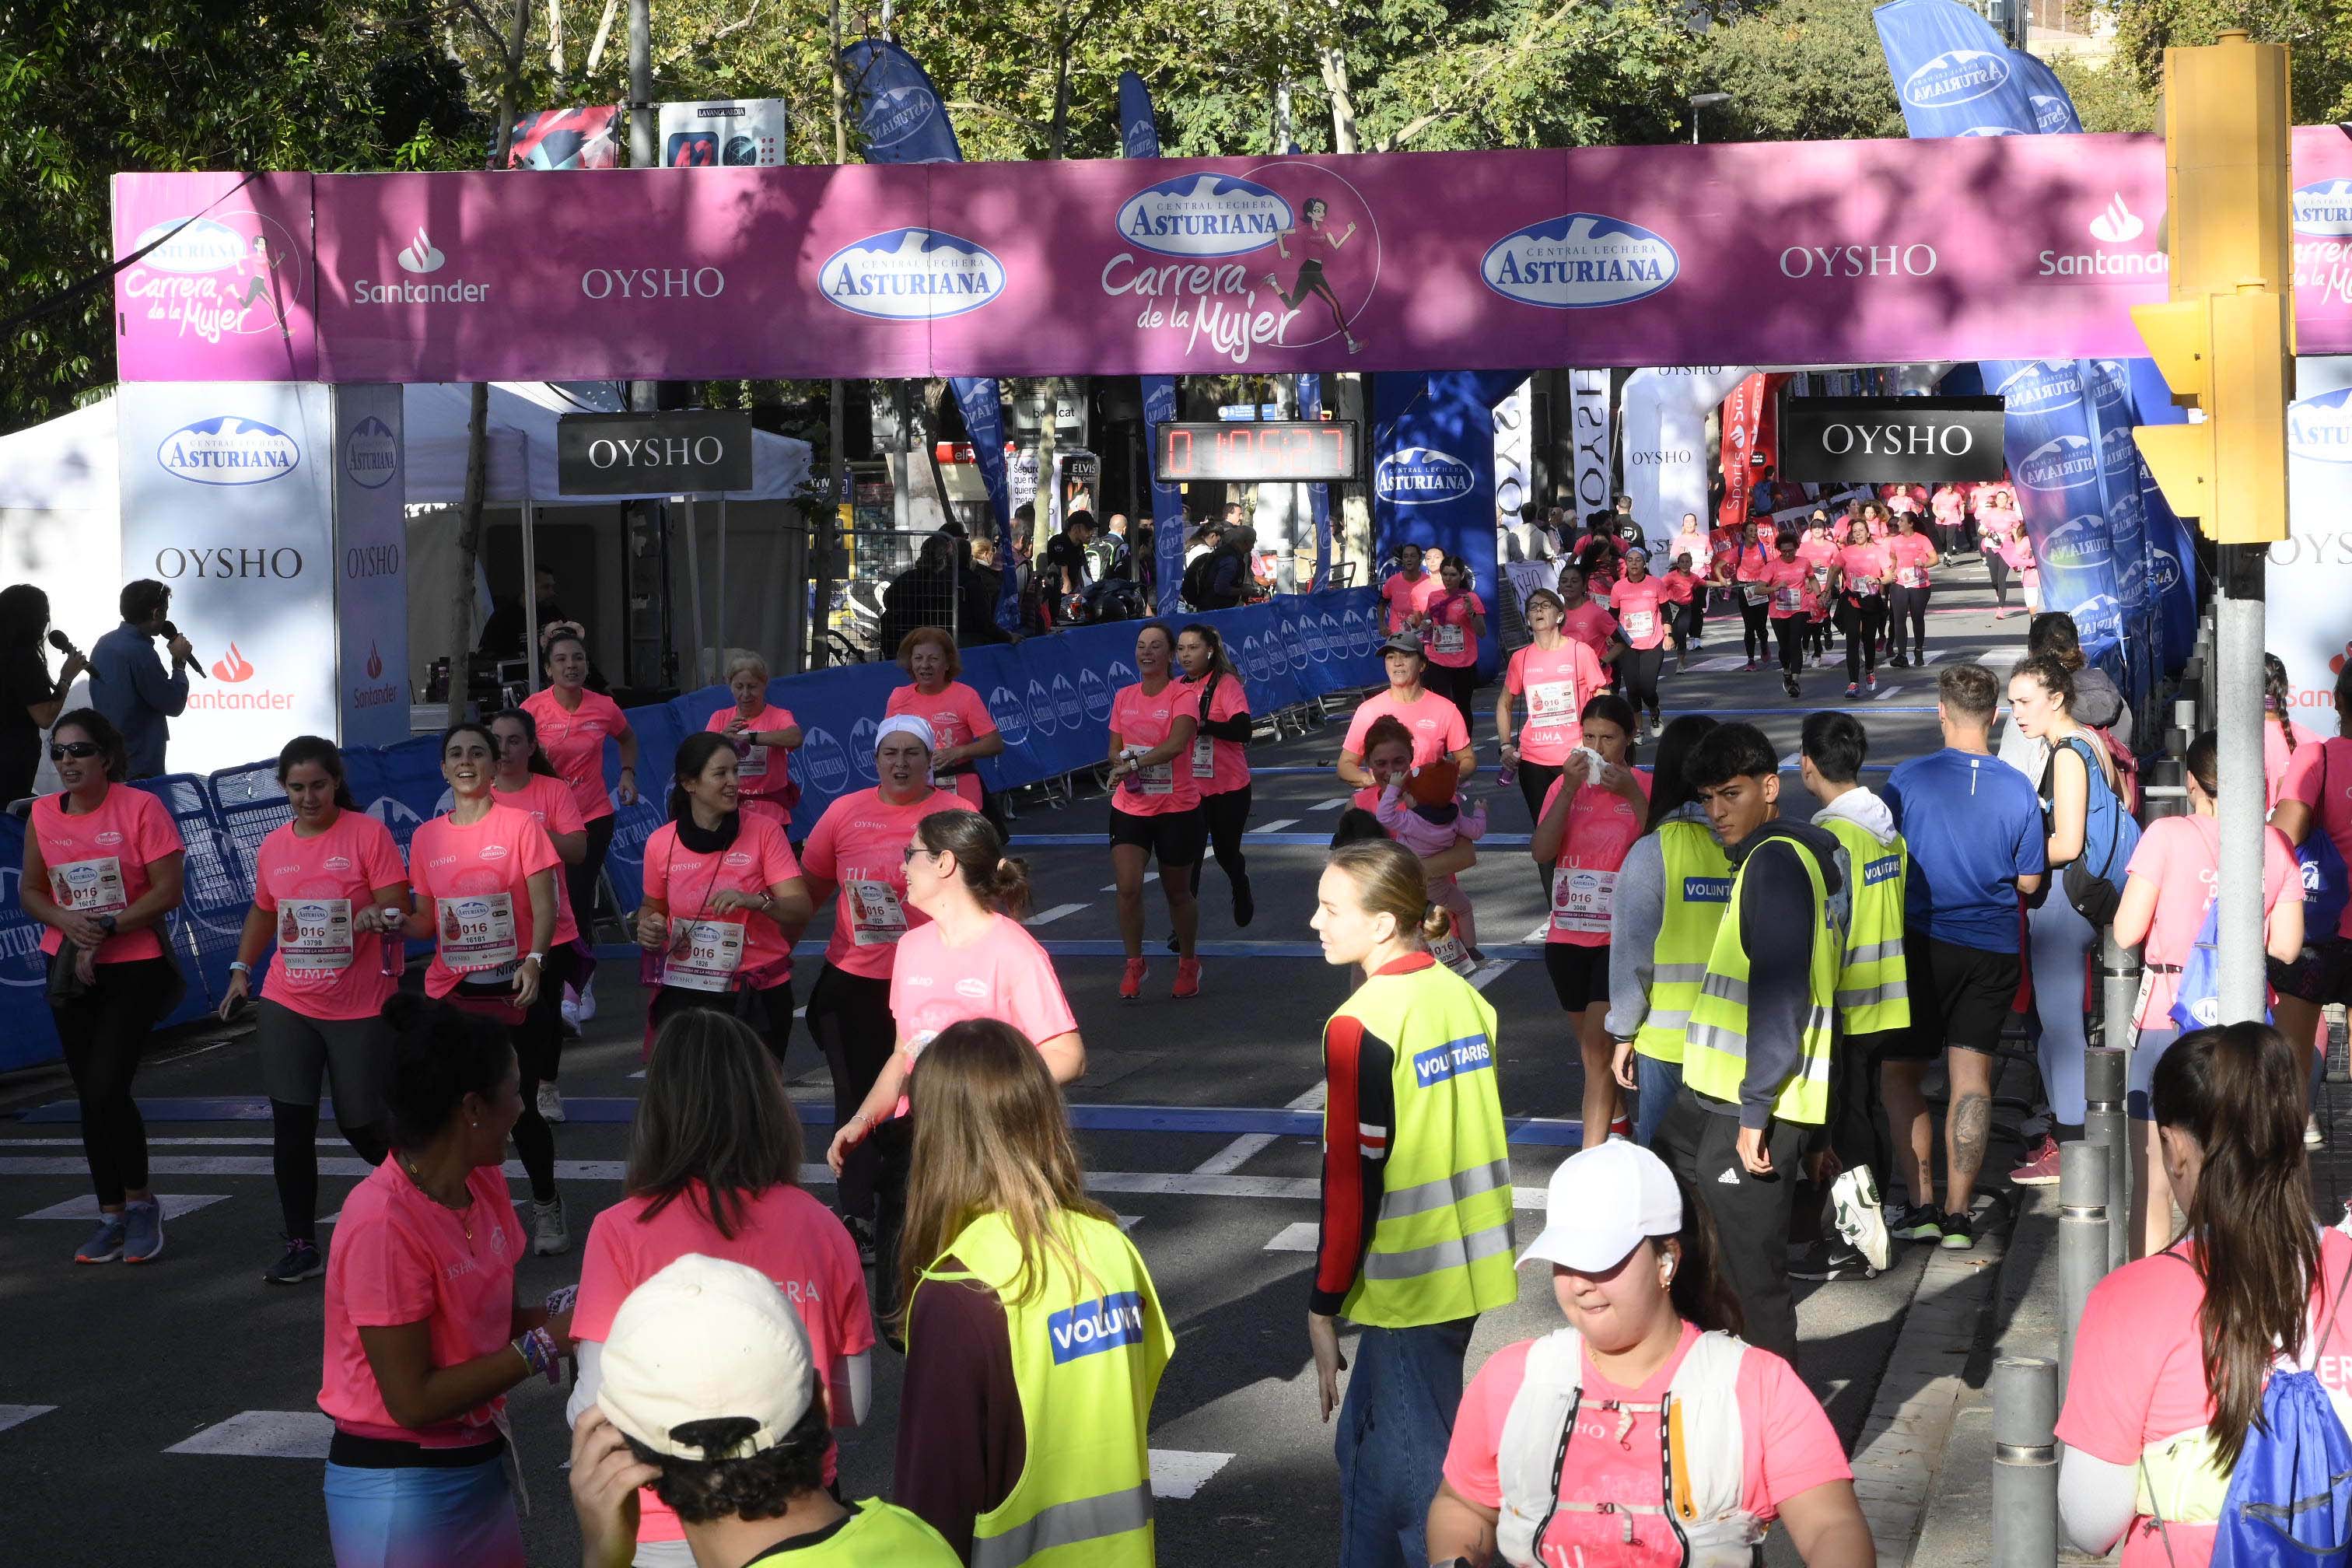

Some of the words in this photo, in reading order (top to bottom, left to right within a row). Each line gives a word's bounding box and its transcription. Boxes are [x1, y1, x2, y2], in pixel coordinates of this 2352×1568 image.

[1157, 202, 1213, 211] CENTRAL
[1218, 200, 1274, 209] LECHERA
[1129, 205, 1279, 236] ASTURIANA
[1527, 246, 1587, 256] CENTRAL
[1594, 244, 1657, 254] LECHERA
[1780, 243, 1937, 278] OYSHO
[862, 260, 920, 269] CENTRAL
[928, 259, 985, 268] LECHERA
[1101, 254, 1247, 296] Carrera
[1496, 250, 1664, 285] ASTURIANA
[2039, 250, 2168, 276] Santand
[124, 268, 217, 299] Carrera
[355, 279, 490, 304] Santander
[582, 267, 725, 299] OYSHO
[833, 263, 991, 296] ASTURIANA
[148, 302, 165, 320] de
[170, 299, 181, 320] la
[179, 295, 252, 343] Mujer
[1137, 299, 1164, 329] de
[1170, 299, 1188, 328] la
[1185, 290, 1302, 363] Mujer
[588, 436, 723, 468] OYSHO
[1822, 424, 1973, 457] OYSHO
[169, 442, 289, 468] ASTURIANA
[1632, 450, 1692, 466] OYSHO
[1073, 464, 1096, 474] ELVIS
[1379, 470, 1467, 492] ASTURIANA
[1727, 451, 1745, 510] Sports
[156, 547, 303, 579] OYSHO
[347, 544, 399, 579] OYSHO
[187, 689, 295, 710] antander
[354, 682, 397, 709] Santander
[1562, 855, 1580, 869] TU
[74, 887, 98, 899] 016
[1570, 893, 1592, 903] 016
[1686, 882, 1732, 897] VOLUNT
[299, 910, 326, 919] ASTURIANA
[867, 905, 885, 916] 016
[301, 926, 326, 937] 016
[462, 922, 488, 934] 016
[693, 947, 715, 959] 016
[1434, 942, 1454, 955] 016
